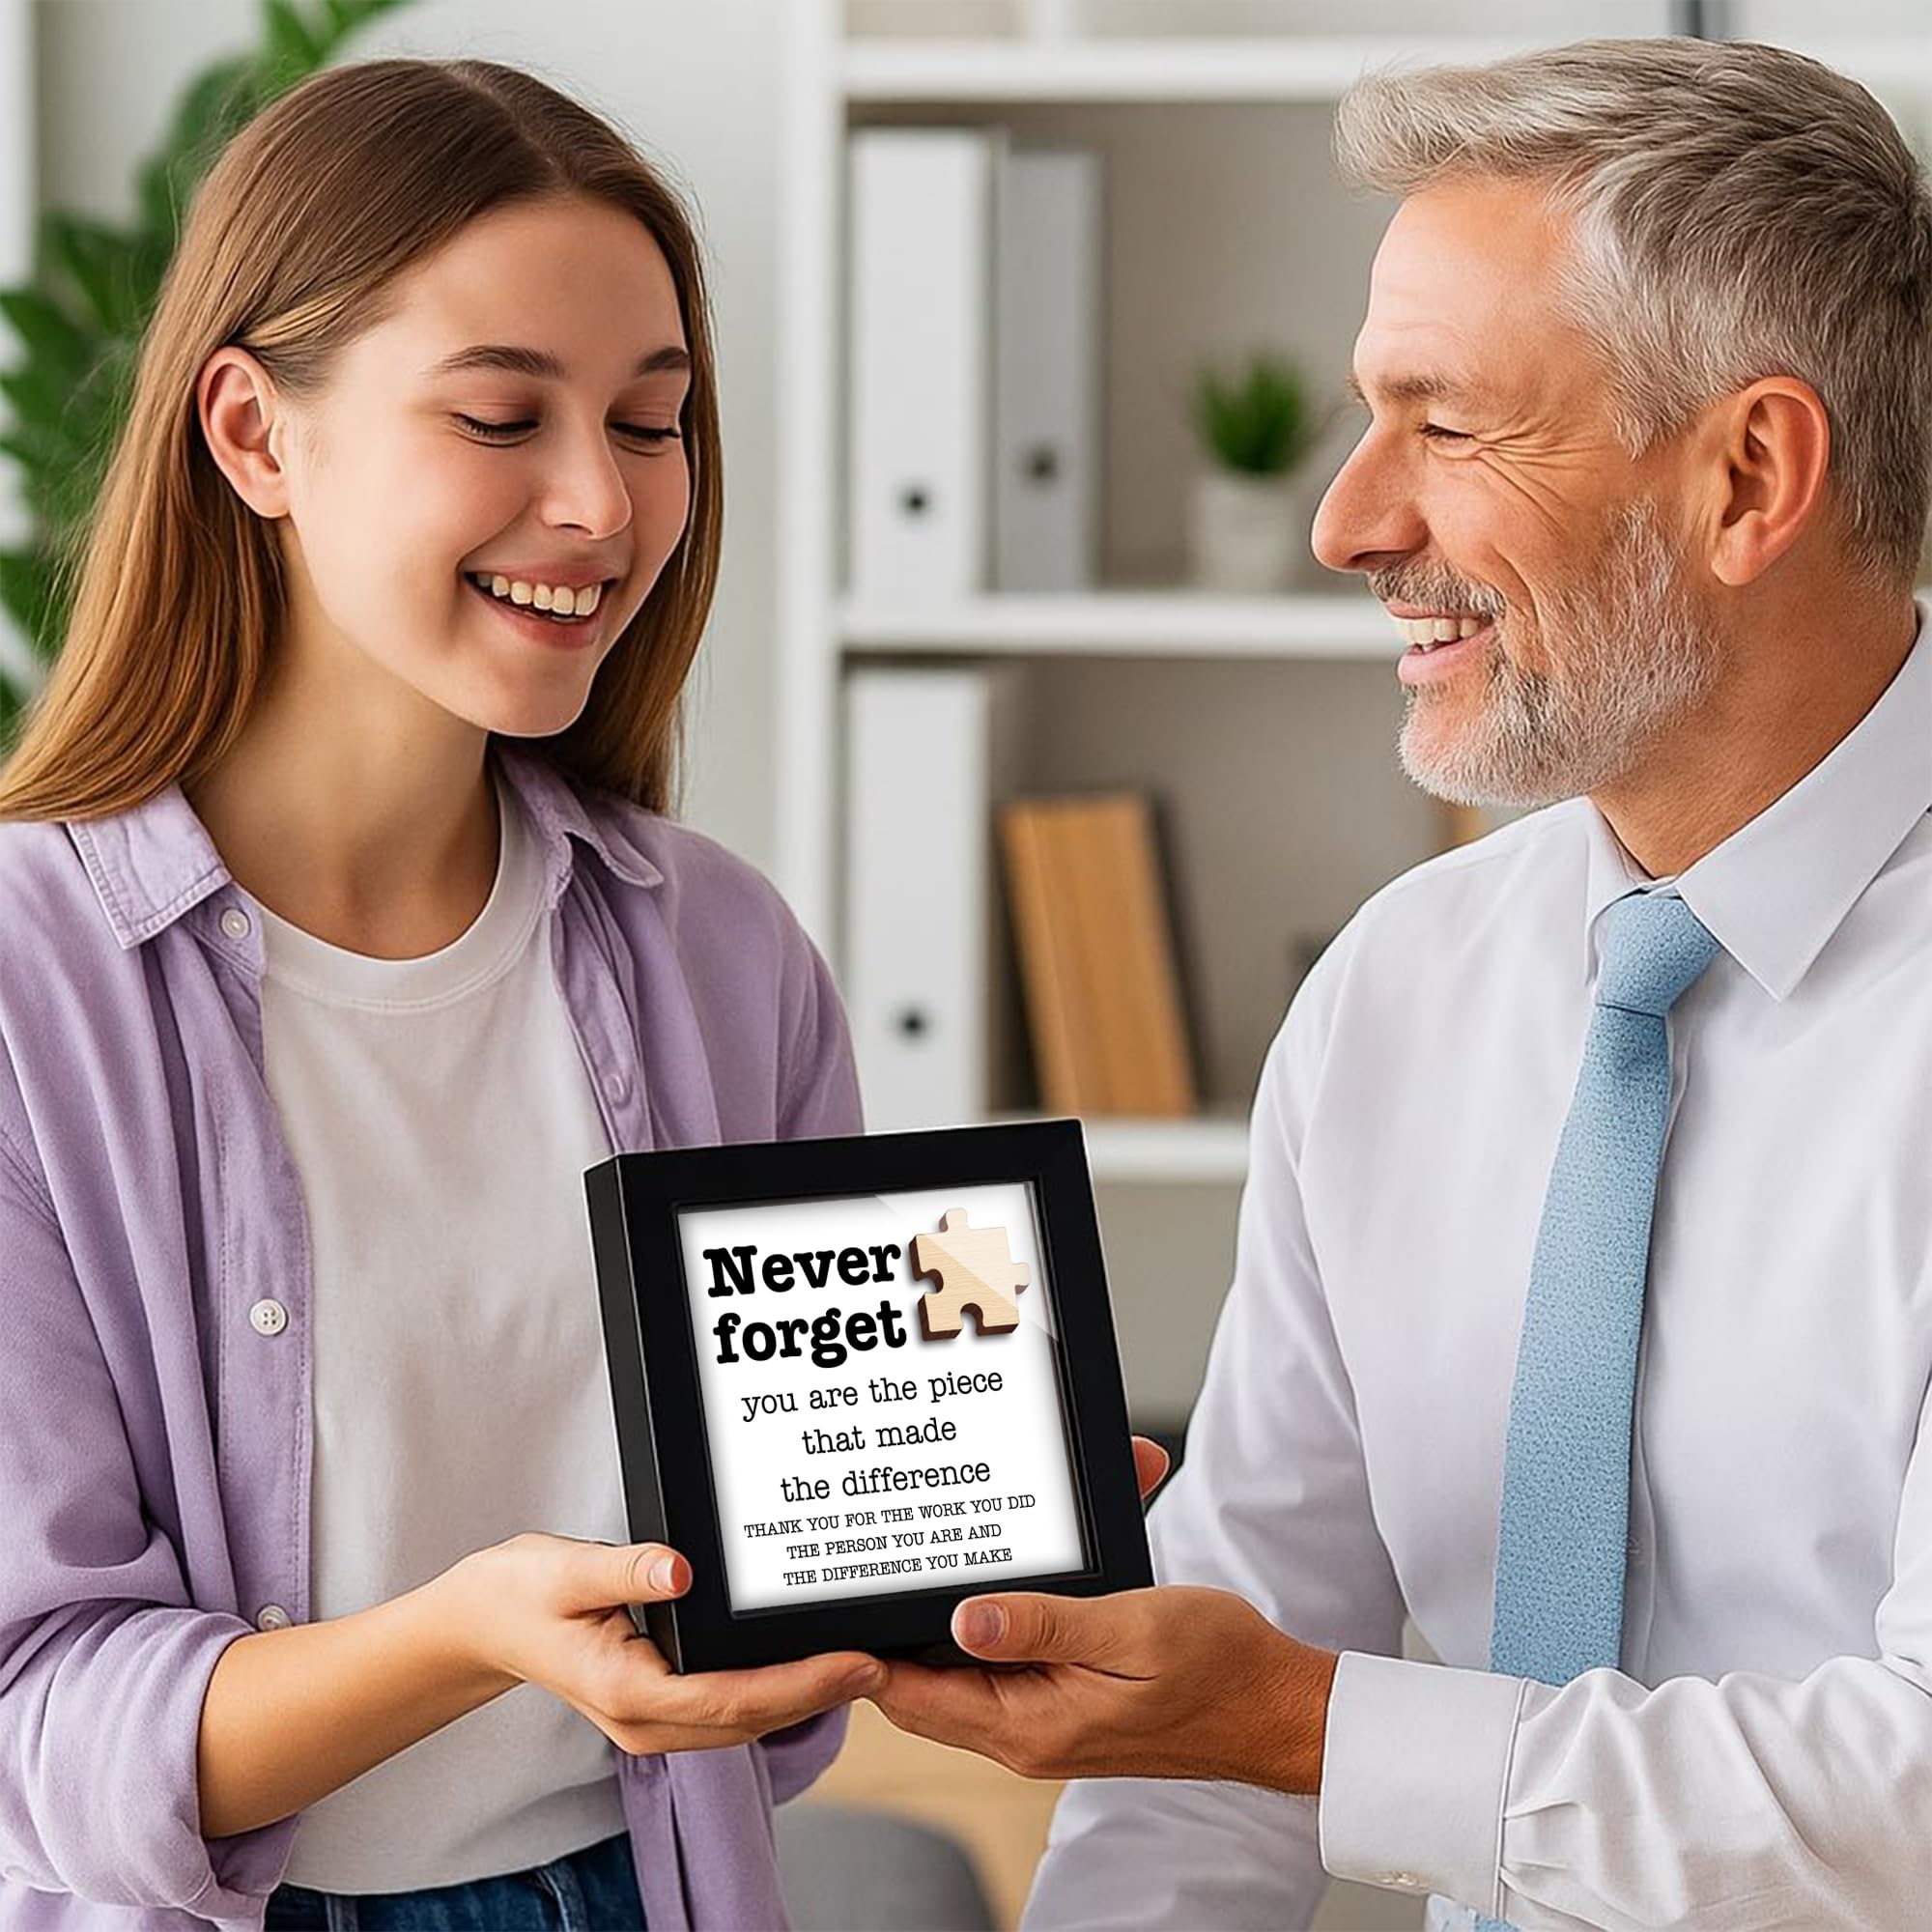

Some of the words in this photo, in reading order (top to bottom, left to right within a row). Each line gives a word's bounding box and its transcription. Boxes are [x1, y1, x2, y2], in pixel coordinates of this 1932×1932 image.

[702, 1243, 902, 1298] Never
[712, 1299, 907, 1369] forget
[740, 1392, 799, 1423] you
[809, 1386, 859, 1410] are
[867, 1377, 918, 1404] the
[927, 1371, 1004, 1404] piece
[801, 1425, 866, 1455] that
[875, 1416, 957, 1448] made
[780, 1476, 831, 1503] the
[841, 1462, 991, 1497] difference
[743, 1519, 804, 1539] THANK
[806, 1515, 839, 1531] YOU
[844, 1511, 878, 1527] FOR
[880, 1507, 914, 1523] THE
[917, 1501, 968, 1520] WORK
[969, 1497, 1003, 1514] YOU
[1007, 1493, 1036, 1510] DID
[785, 1543, 820, 1560] THE
[824, 1535, 888, 1556] PERSON
[891, 1531, 924, 1548] YOU
[929, 1527, 963, 1545] ARE
[967, 1523, 1002, 1540] AND
[782, 1569, 817, 1586] THE
[821, 1557, 923, 1582] DIFFERENCE
[924, 1553, 958, 1570] YOU
[963, 1548, 1012, 1566] MAKE
